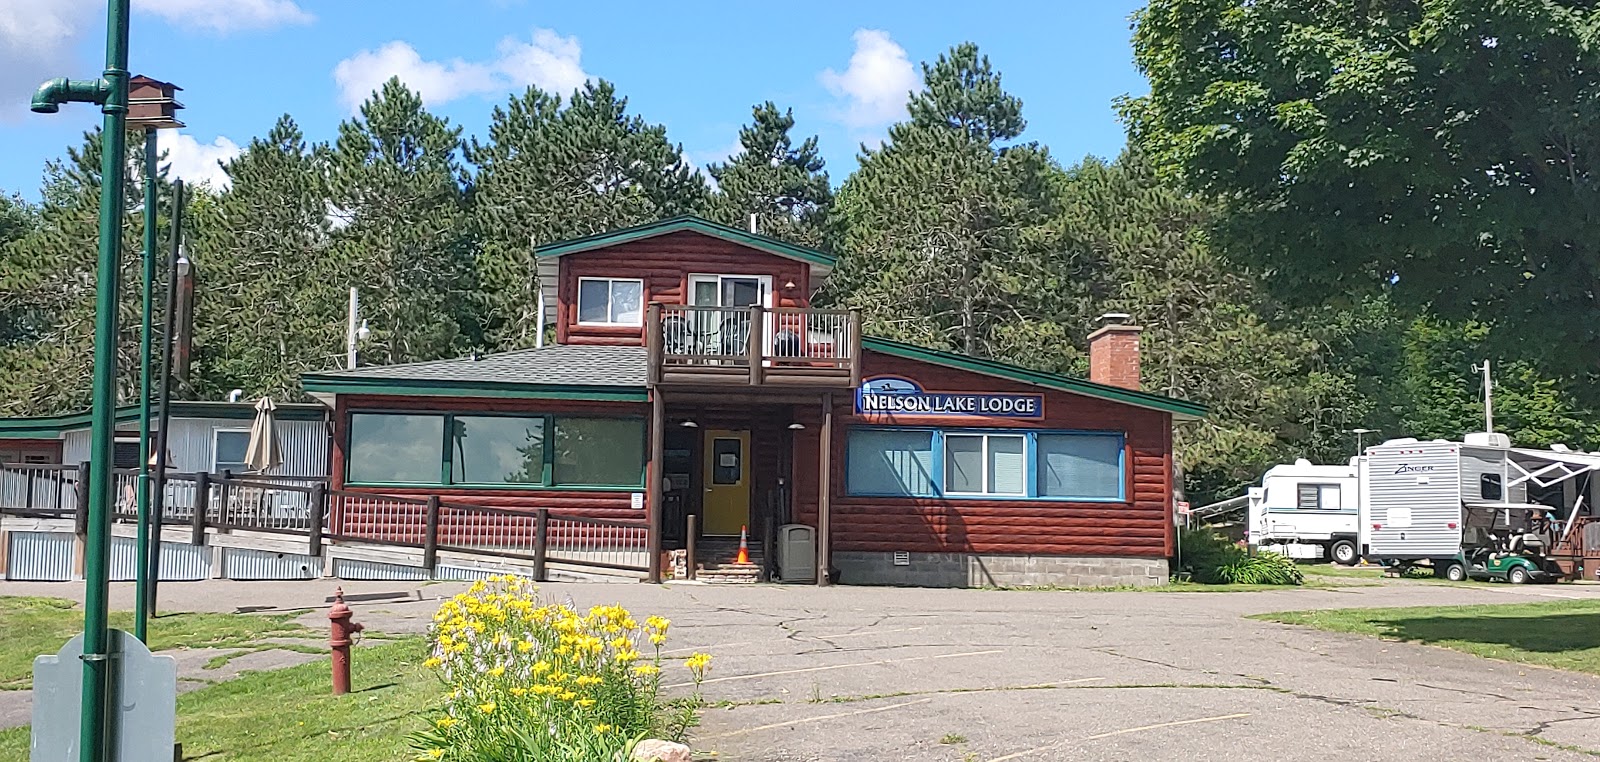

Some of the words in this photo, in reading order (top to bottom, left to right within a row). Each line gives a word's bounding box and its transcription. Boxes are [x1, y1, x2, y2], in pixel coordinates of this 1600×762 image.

[864, 394, 930, 412] NELSON
[934, 396, 975, 412] LAKE
[980, 397, 1035, 414] LODGE
